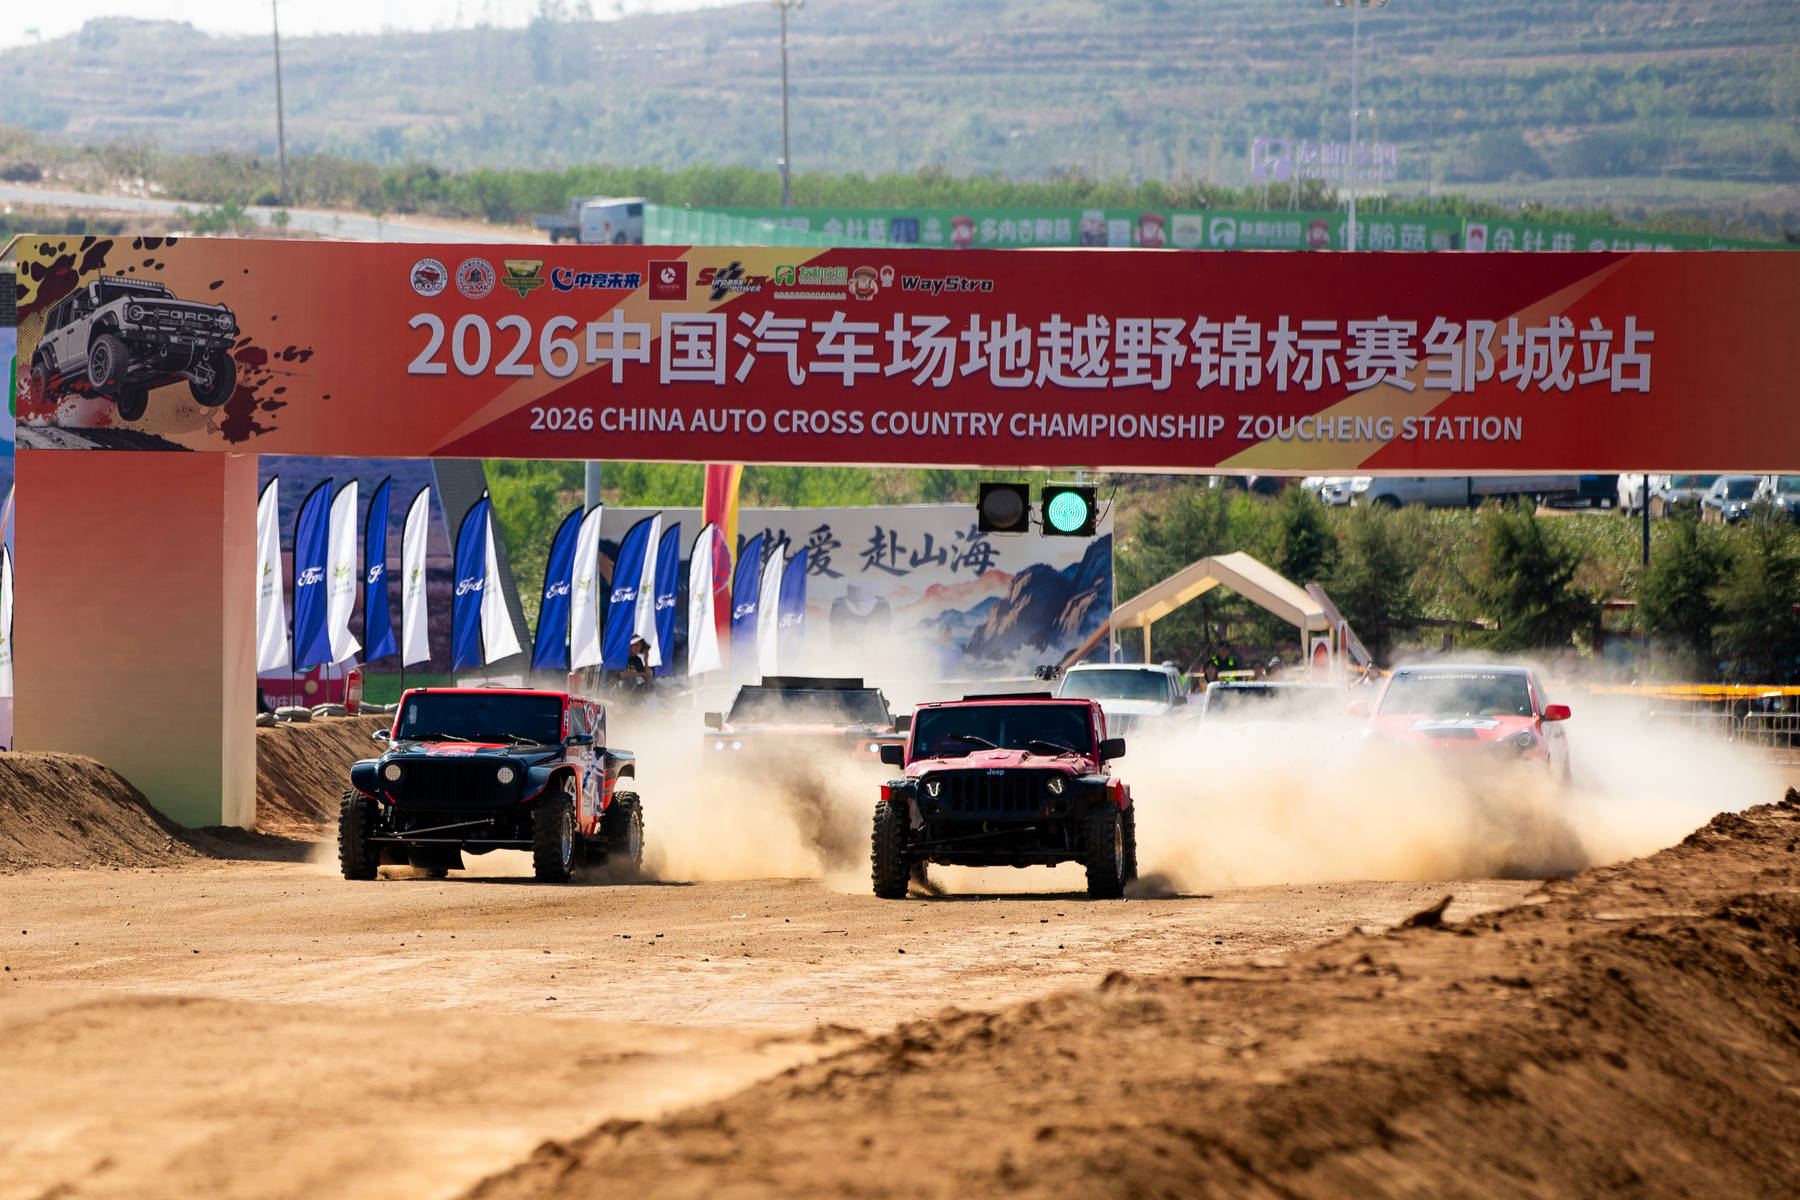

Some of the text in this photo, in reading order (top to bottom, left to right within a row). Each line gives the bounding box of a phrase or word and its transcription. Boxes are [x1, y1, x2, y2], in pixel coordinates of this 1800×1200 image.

[573, 272, 641, 289] 中竞未来
[902, 276, 994, 295] WayStro
[408, 309, 1654, 393] 2026中国汽车场地越野锦标赛邹城站
[530, 407, 1523, 442] 2026 CHINA AUTO CROSS COUNTRY CHAMPIONSHIP ZOUCHENG STATION
[859, 524, 1000, 577] 赴山海
[986, 768, 1005, 776] Jeep
